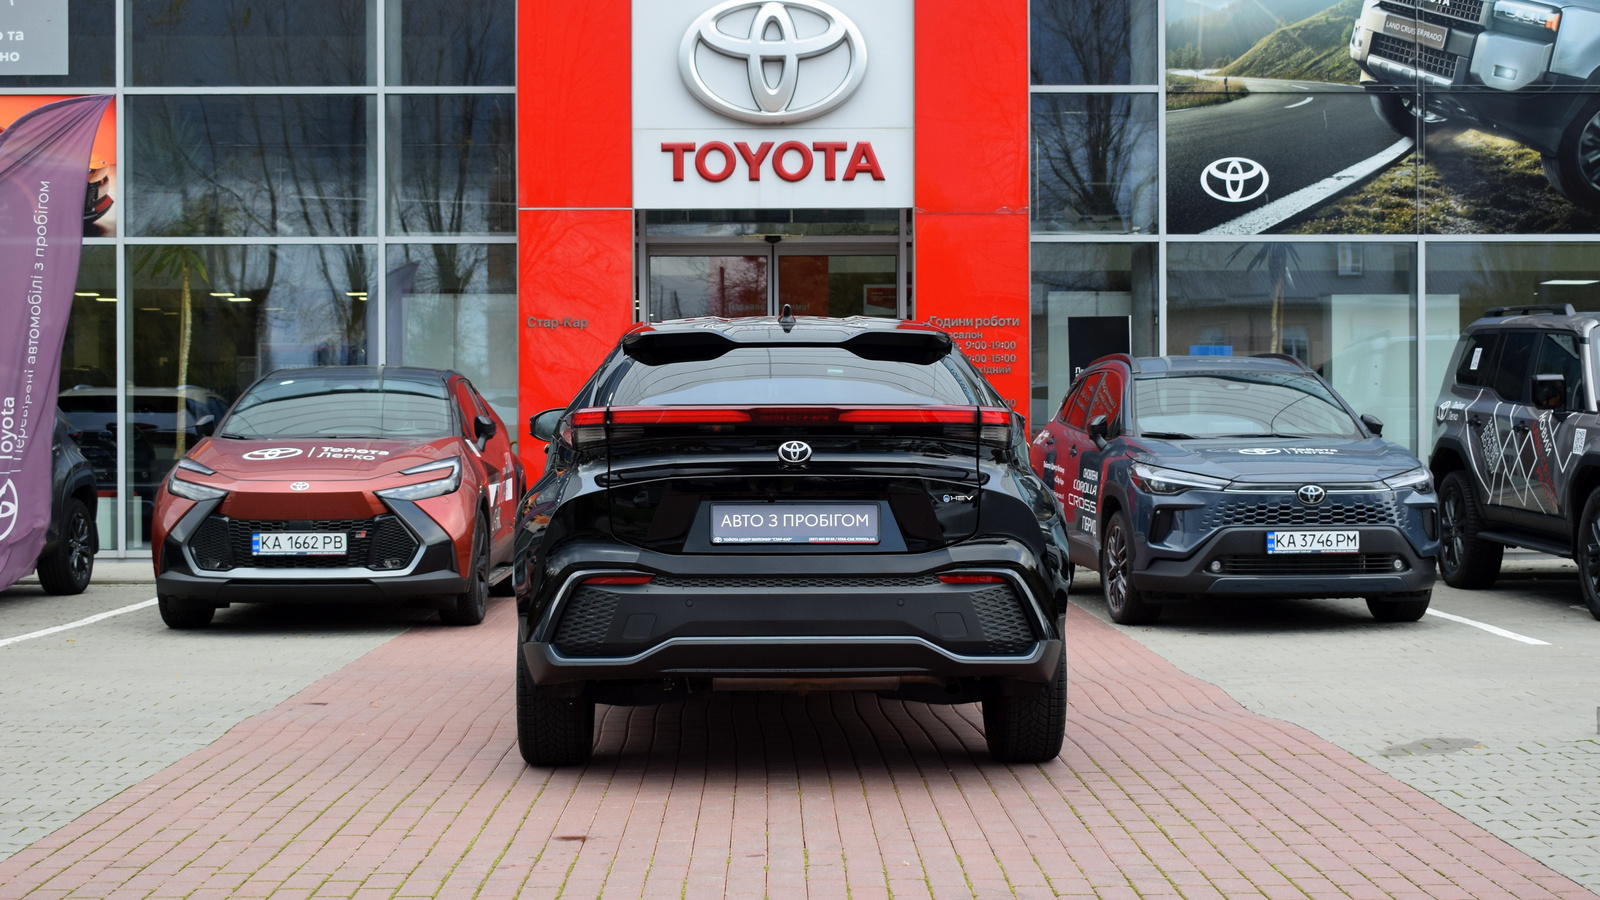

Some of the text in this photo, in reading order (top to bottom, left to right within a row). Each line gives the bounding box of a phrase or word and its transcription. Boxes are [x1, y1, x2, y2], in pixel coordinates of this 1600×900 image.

[1385, 20, 1443, 42] LAND CRUISER PRADO
[660, 140, 886, 183] TOYOTA
[33, 180, 50, 257] пробігом
[34, 262, 44, 271] з
[27, 275, 43, 364] автомобілі
[526, 315, 589, 330] Стар-Кар
[929, 315, 1020, 329] Години роботи
[978, 365, 1012, 375] хідний
[1538, 410, 1553, 458] НОВИЙ
[317, 452, 376, 461] Легко
[321, 446, 390, 456] Тойота
[1072, 479, 1098, 496] COROLLA
[1068, 493, 1097, 514] CROSS
[721, 513, 870, 528] АВТО З ПРОБІГОМ
[260, 536, 283, 550] KA
[287, 535, 319, 550] 1662
[322, 535, 344, 550] PB
[1275, 534, 1297, 548] KA
[1300, 533, 1333, 548] 3746
[1335, 533, 1357, 548] PM
